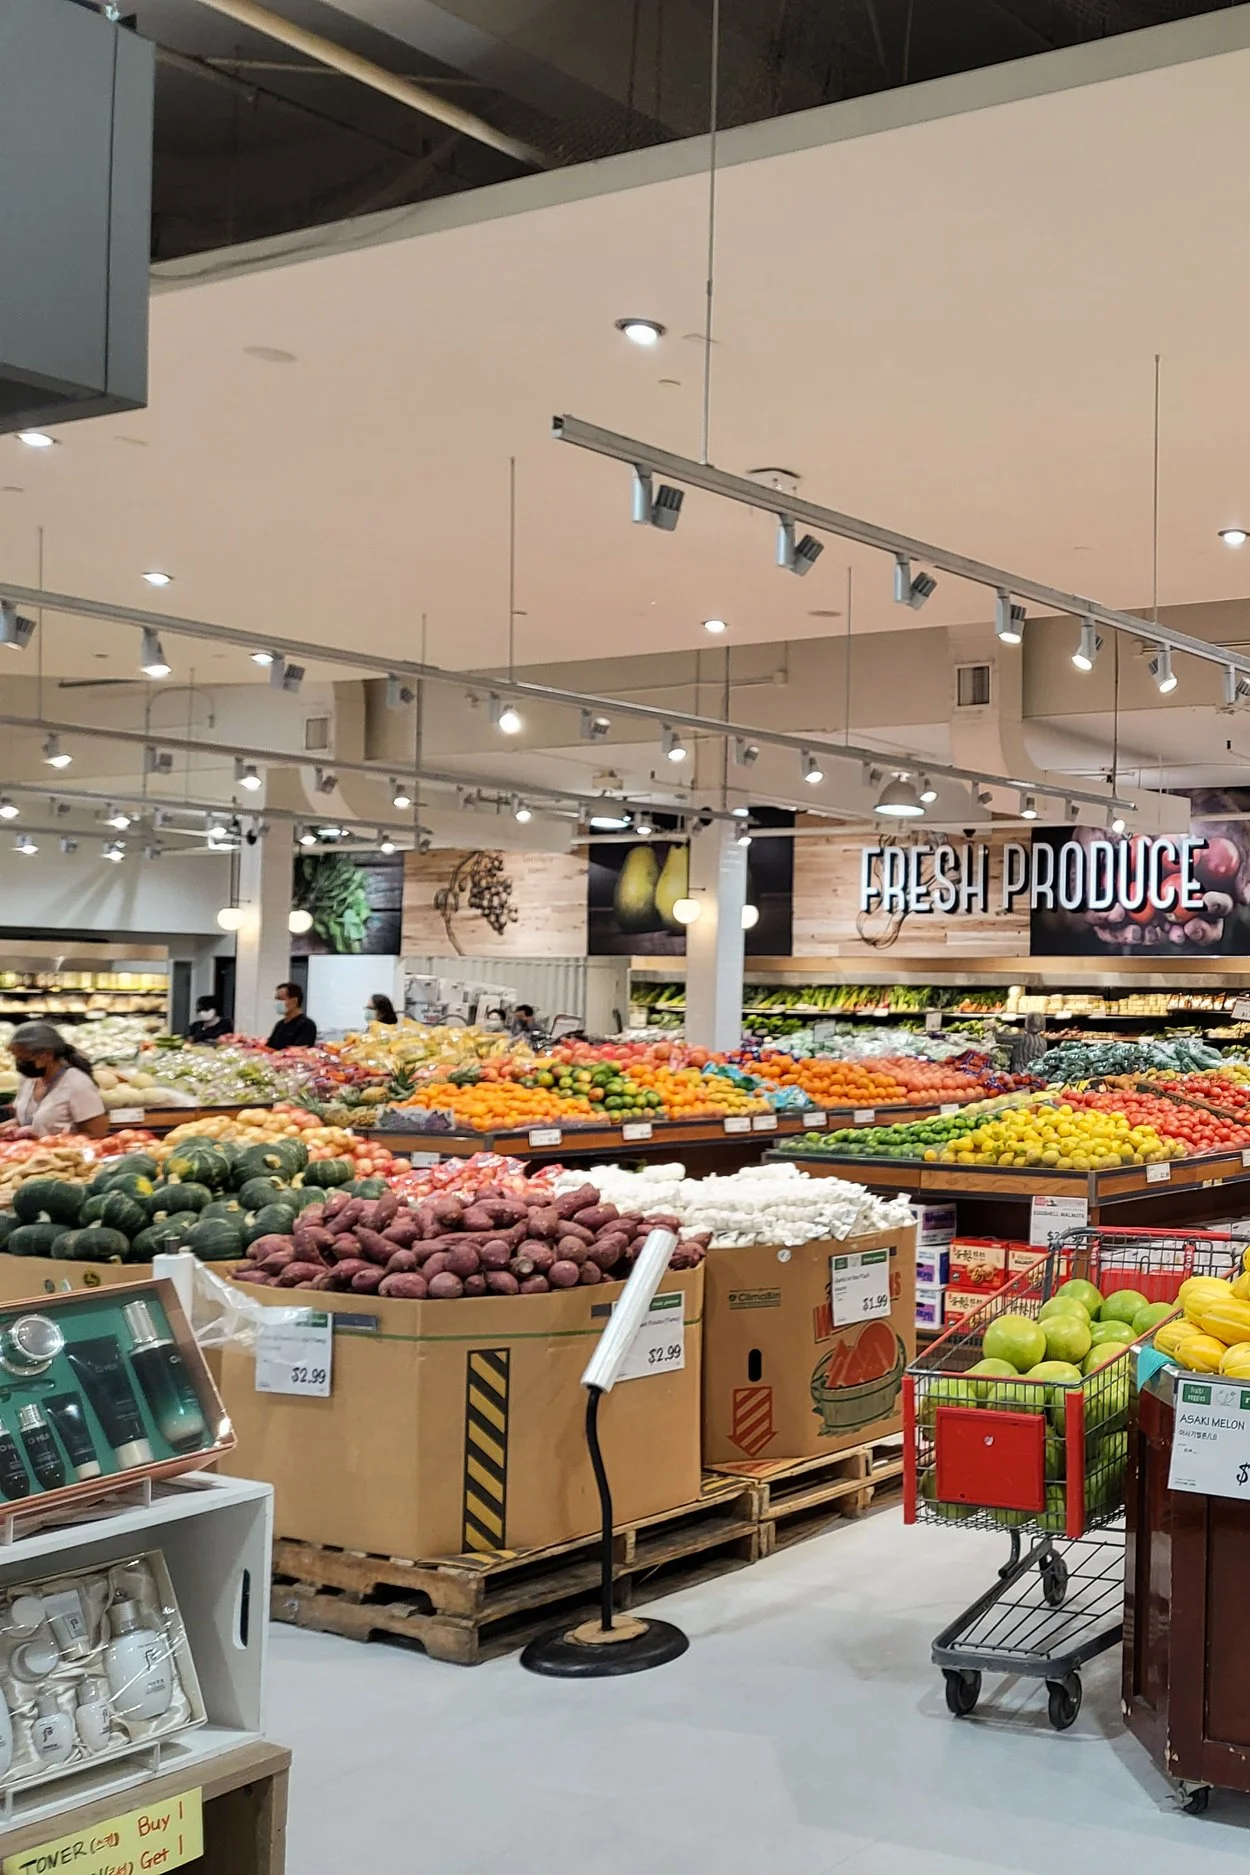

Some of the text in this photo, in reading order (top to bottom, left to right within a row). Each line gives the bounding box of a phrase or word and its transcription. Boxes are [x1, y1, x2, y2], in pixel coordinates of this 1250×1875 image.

[860, 838, 1208, 913] FRESH PRODUCE
[862, 1294, 888, 1311] $1.99
[648, 1344, 682, 1366] $2.99
[291, 1367, 326, 1384] $2.99
[1179, 1414, 1245, 1430] ASAKI MELON
[137, 1814, 171, 1837] Buy
[140, 1848, 170, 1870] Get
